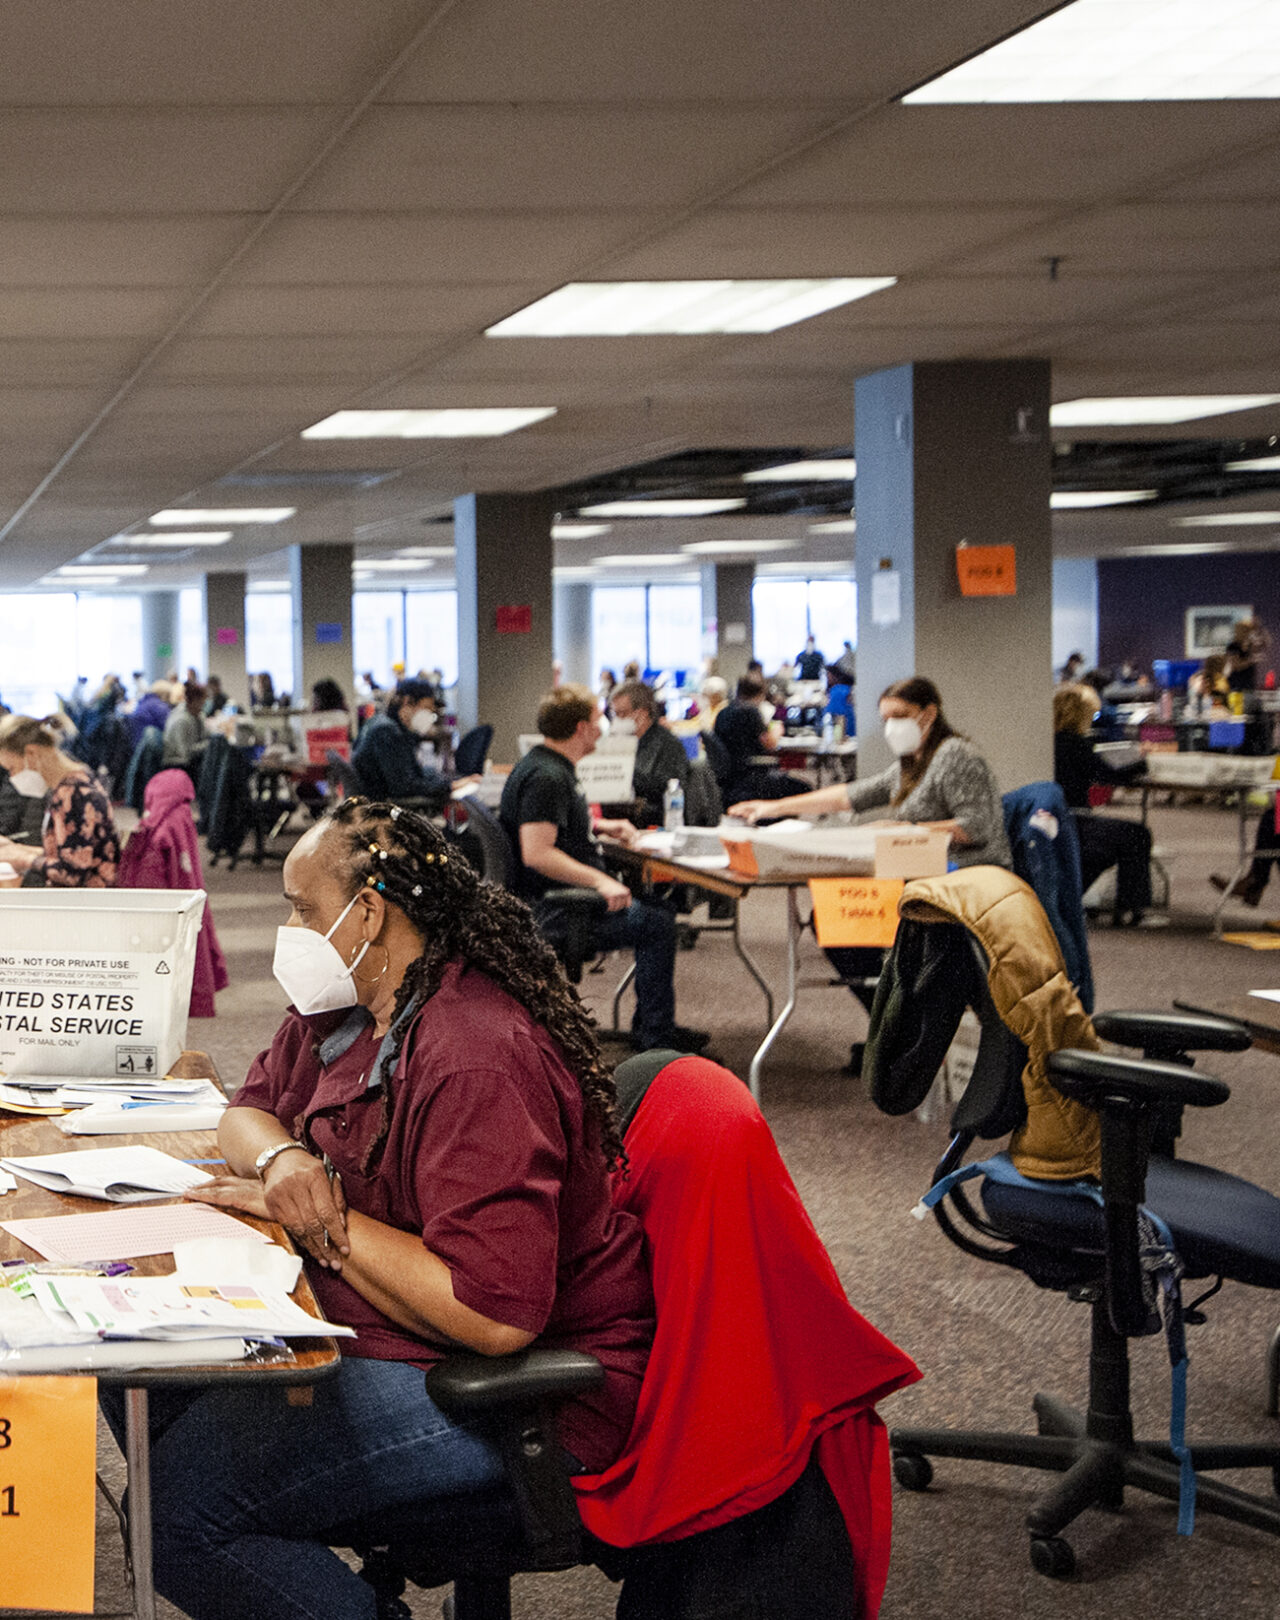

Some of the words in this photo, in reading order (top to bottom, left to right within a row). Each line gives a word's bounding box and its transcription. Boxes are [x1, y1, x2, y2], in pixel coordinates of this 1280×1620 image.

[839, 906, 874, 918] Table
[23, 957, 44, 967] NOT
[45, 958, 66, 968] FOR
[68, 959, 108, 969] PRIVATE
[110, 961, 130, 969] USE
[51, 993, 134, 1011] STATES
[50, 1017, 144, 1036] SERVICE
[19, 1037, 35, 1045] FOR
[38, 1038, 56, 1046] MAIL
[1, 1485, 20, 1516] 1
